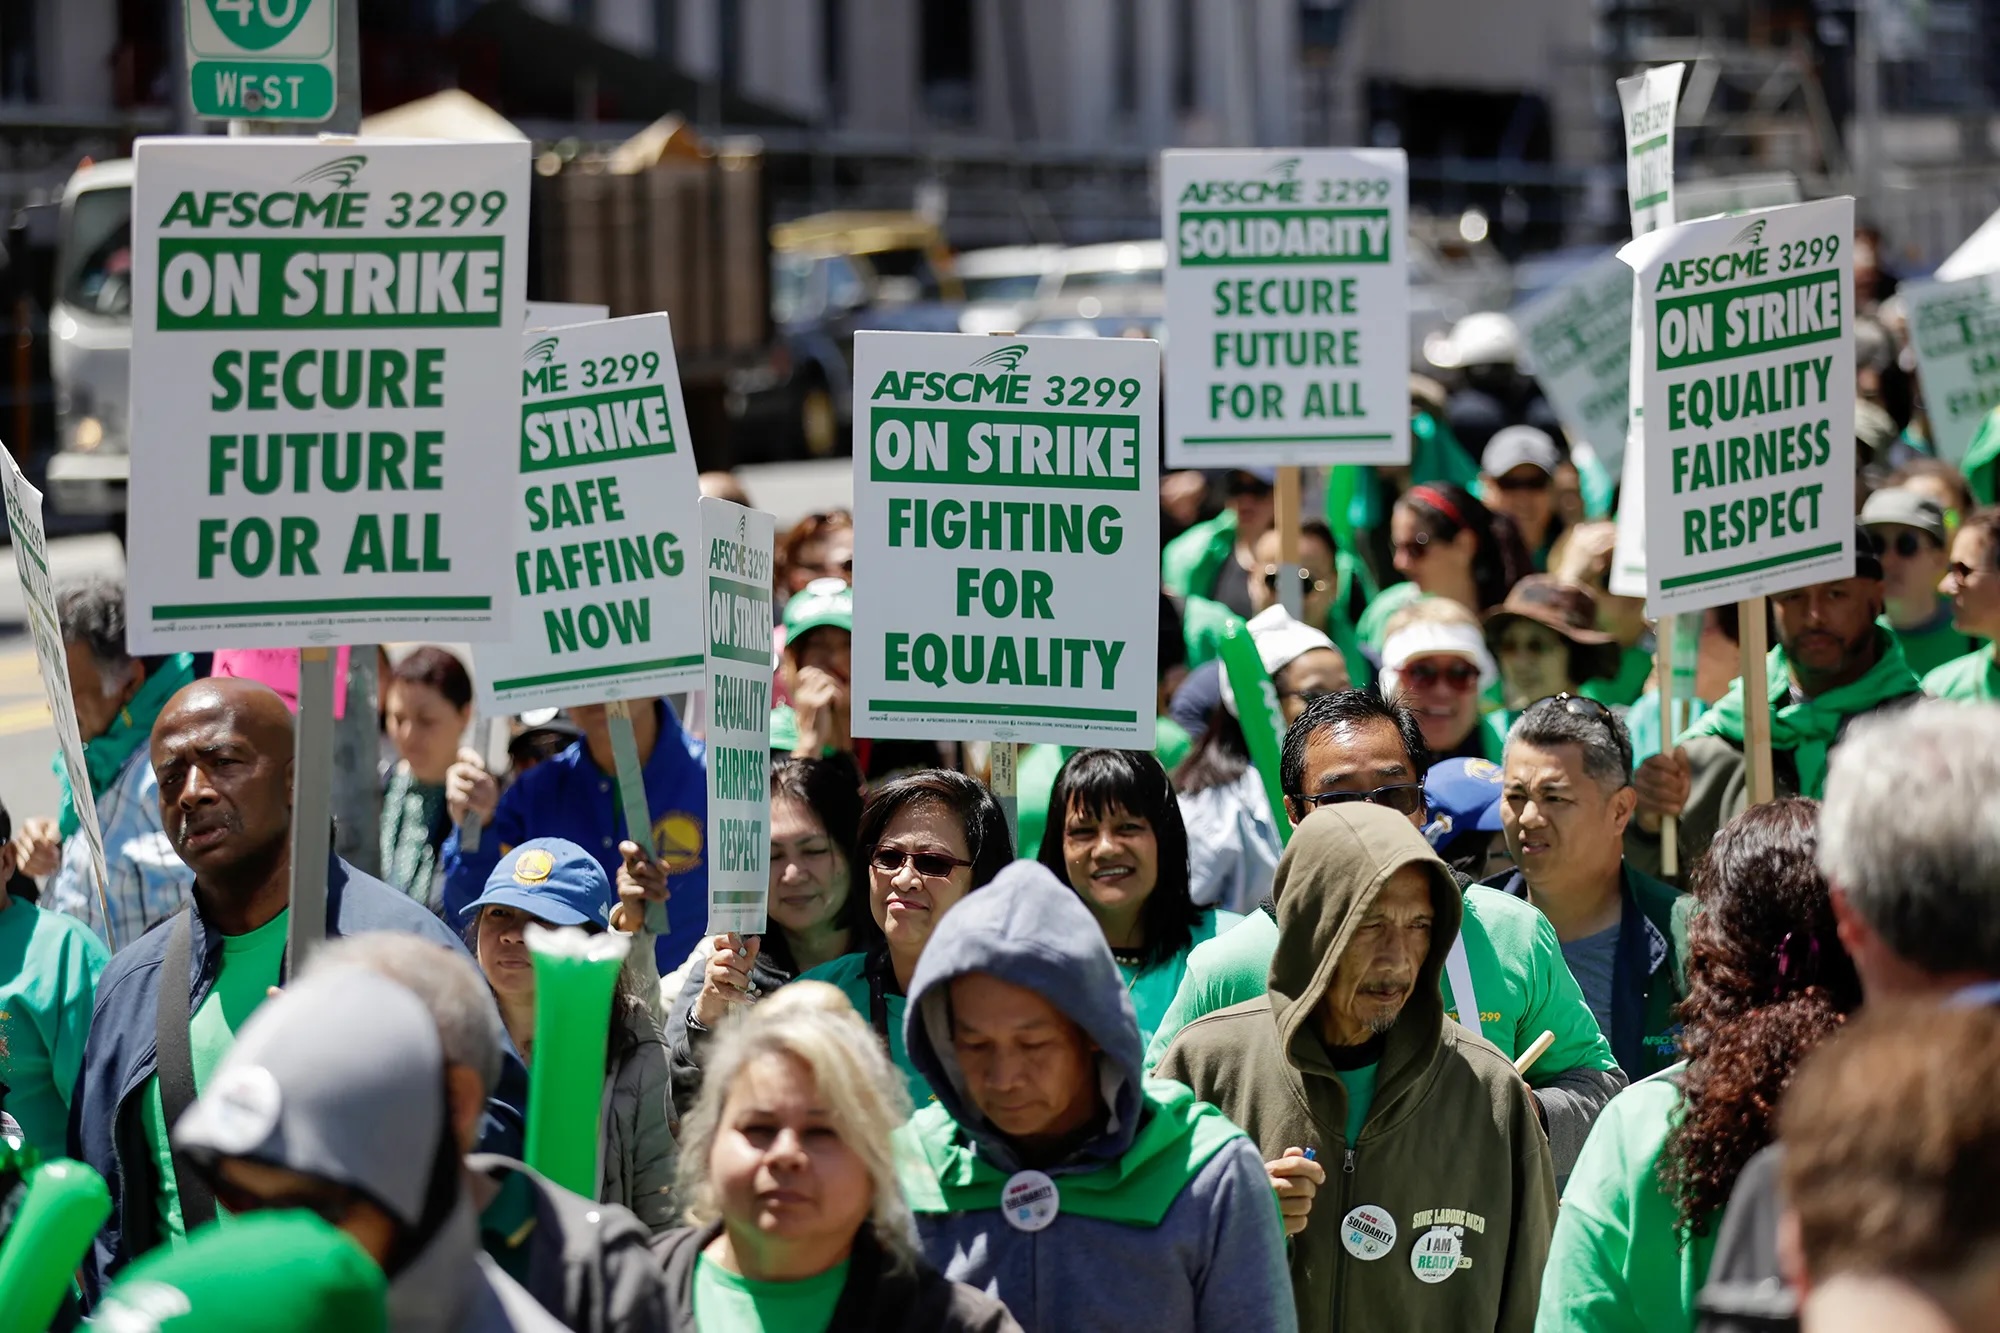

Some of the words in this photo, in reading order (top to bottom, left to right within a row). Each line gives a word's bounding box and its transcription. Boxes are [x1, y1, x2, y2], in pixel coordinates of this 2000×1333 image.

[215, 70, 304, 109] WEST
[159, 190, 368, 229] AFSCME
[385, 189, 508, 229] 3299
[1180, 181, 1304, 205] AFSCME
[1314, 179, 1390, 203] 3299
[1180, 214, 1389, 260] SOLIDARITY
[1655, 245, 1770, 292] AFSCME
[1778, 234, 1840, 272] 3299
[163, 252, 260, 318] ON
[283, 250, 500, 317] STRIKE
[1214, 278, 1357, 317] SECURE
[1659, 302, 1714, 355] ON
[1725, 279, 1840, 348] STRIKE
[581, 351, 660, 388] 3299
[1214, 329, 1359, 369] FUTURE
[211, 348, 446, 412] SECURE
[871, 371, 1030, 406] AFSCME
[1043, 376, 1141, 408] 3299
[1209, 381, 1284, 420] FOR
[1303, 381, 1366, 419] ALL
[1668, 356, 1832, 431] EQUALITY
[524, 395, 671, 462] STRIKE
[874, 419, 949, 472] ON
[967, 422, 1136, 479] STRIKE
[1672, 419, 1830, 494] FAIRNESS
[208, 431, 444, 496] FUTURE
[524, 475, 625, 533] SAFE
[888, 497, 1124, 555] FIGHTING
[1683, 484, 1823, 556] RESPECT
[198, 517, 319, 578] FOR
[344, 513, 450, 574] ALL
[516, 531, 684, 596] TAFFING
[709, 536, 747, 576] AFSCME
[748, 546, 770, 582] 3299
[711, 589, 731, 646] ON
[733, 594, 770, 653] STRIKE
[956, 567, 1055, 620] FOR
[543, 597, 651, 654] NOW
[884, 631, 1126, 691] EQUALITY
[714, 674, 767, 734] EQUALITY
[715, 745, 765, 803] FAIRNESS
[718, 817, 763, 873] RESPECT
[1480, 1011, 1501, 1023] 299
[1005, 1185, 1052, 1210] SOLIDARITY
[1347, 1215, 1393, 1243] SOLIDARITY
[1427, 1237, 1432, 1251] I
[1433, 1237, 1452, 1252] AM
[1417, 1255, 1455, 1269] READY
